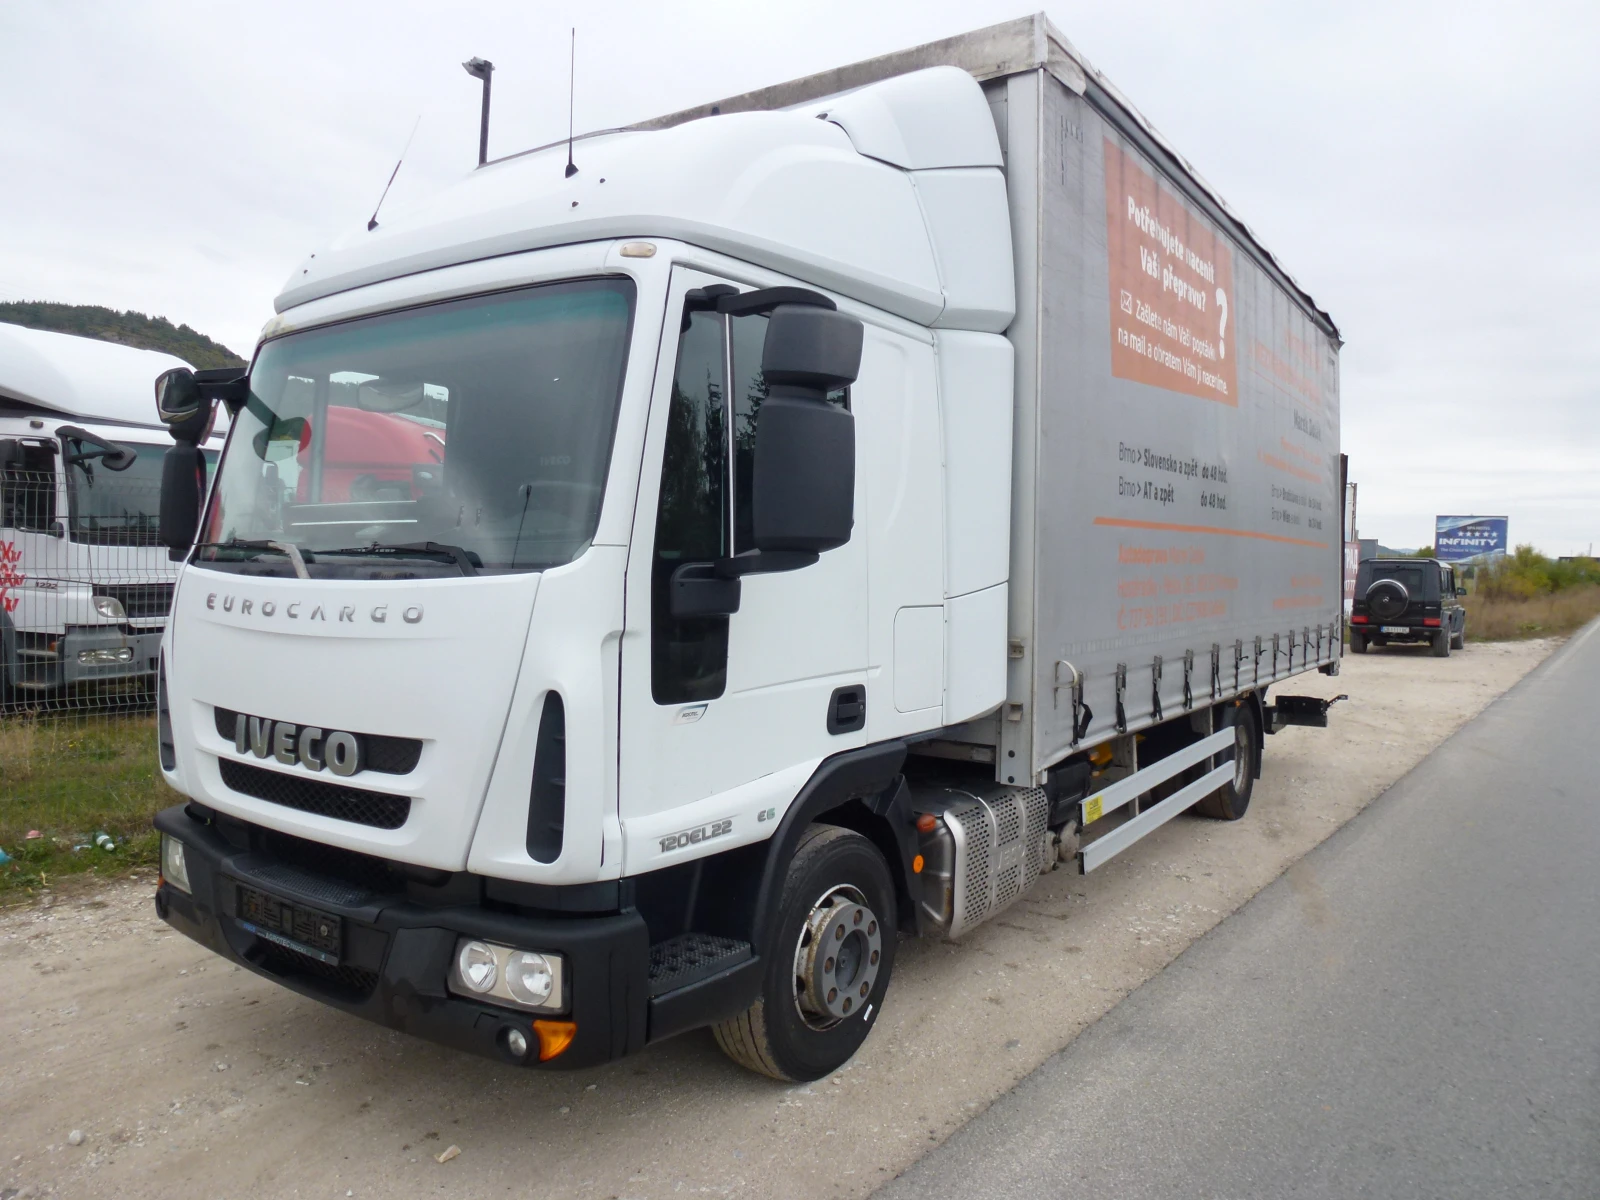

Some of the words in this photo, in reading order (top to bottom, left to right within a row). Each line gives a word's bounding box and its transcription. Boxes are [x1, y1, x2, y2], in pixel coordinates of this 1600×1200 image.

[1128, 196, 1183, 260] Potřebujete
[1186, 247, 1215, 284] nacenit
[1140, 246, 1160, 280] Vaši
[1163, 263, 1206, 312] přepravu?
[1136, 300, 1162, 330] Zašlete
[1118, 327, 1128, 346] na
[1130, 334, 1146, 357] mail
[1147, 343, 1153, 358] a
[1153, 343, 1182, 373] obratem
[1119, 442, 1135, 463] Brno
[1144, 448, 1177, 473] Slovensko
[1179, 460, 1183, 475] a
[1184, 458, 1198, 480] zpět
[1202, 462, 1209, 479] do
[1119, 475, 1135, 497] Brno
[1143, 481, 1152, 500] AT
[1154, 486, 1158, 500] a
[1160, 482, 1174, 507] zpět
[1200, 491, 1207, 507] do
[1438, 537, 1498, 546] INFINITY
[35, 581, 58, 590] 1222
[206, 592, 425, 624] EUROCARGO
[235, 713, 361, 777] IVECO
[757, 807, 776, 823] E6
[658, 819, 733, 853] 120EL22
[265, 932, 290, 948] AGROTEC
